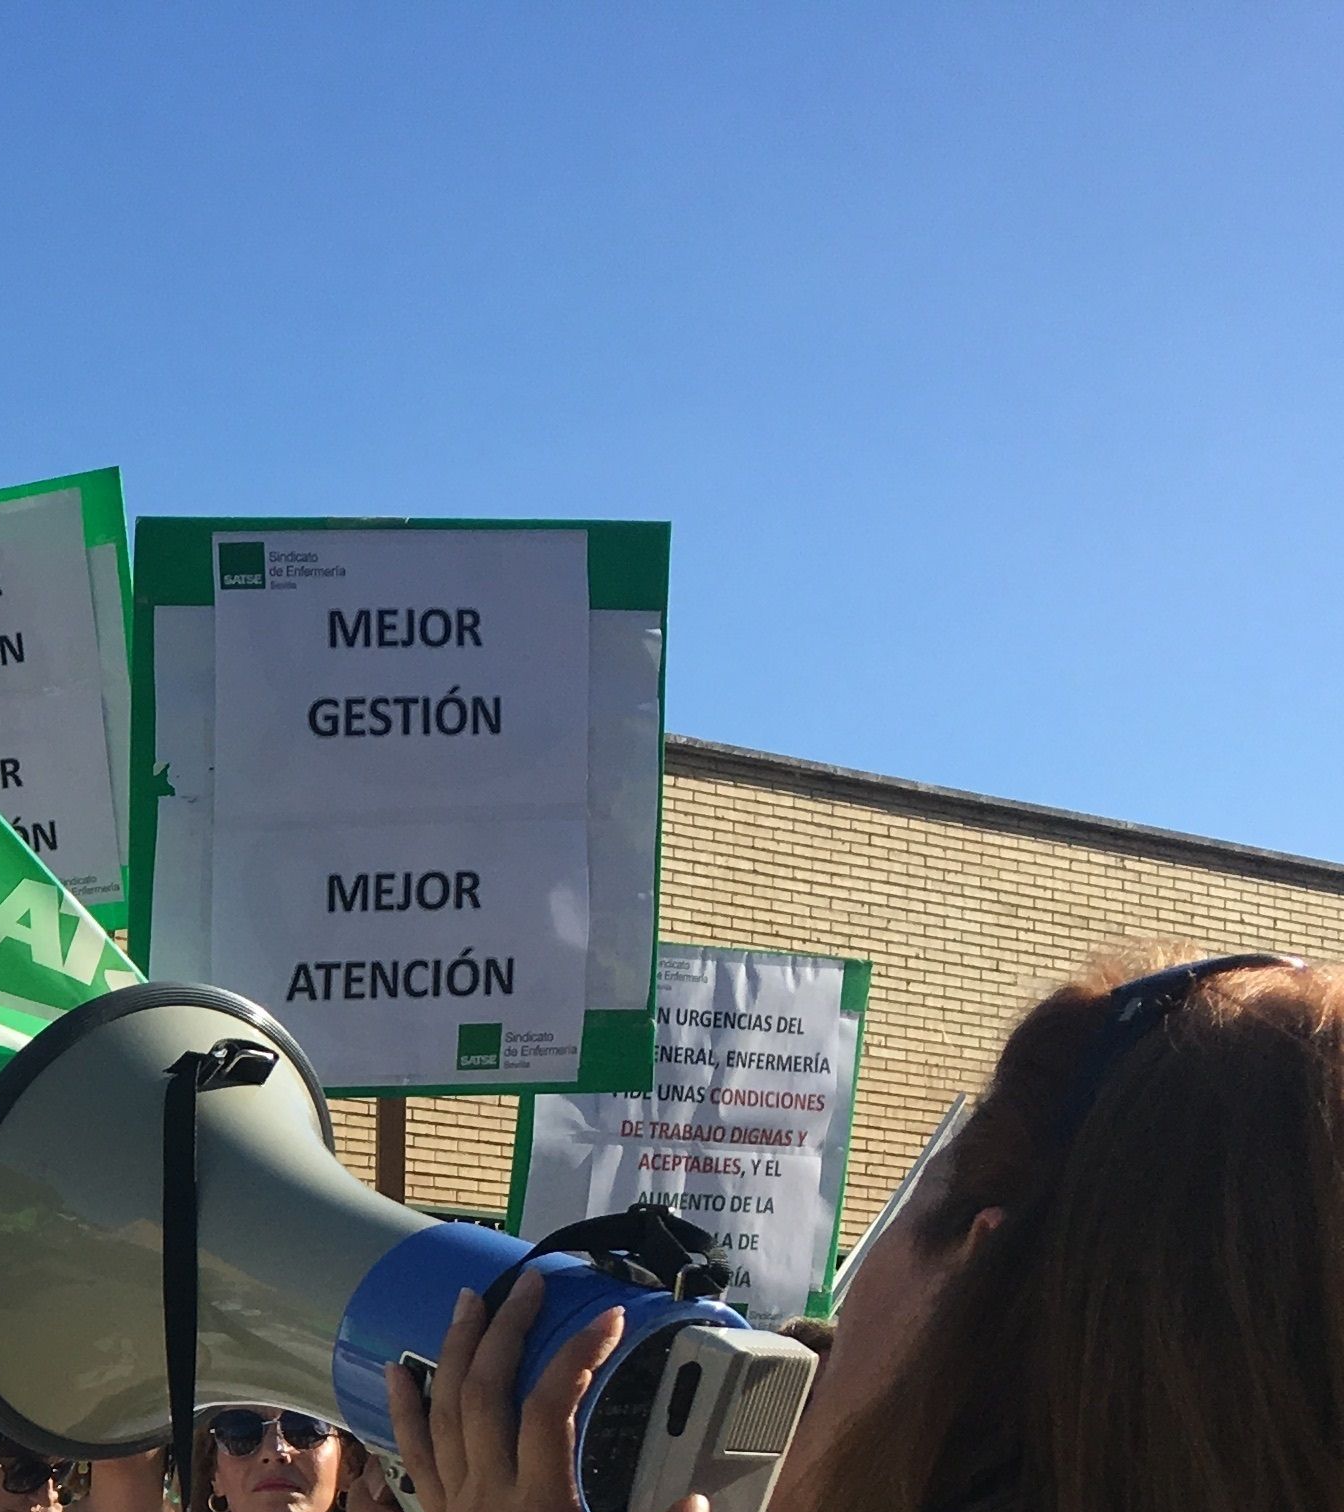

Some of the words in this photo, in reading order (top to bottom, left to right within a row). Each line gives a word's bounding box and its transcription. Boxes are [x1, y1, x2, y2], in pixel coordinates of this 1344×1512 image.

[269, 551, 319, 563] Sindicato
[328, 608, 483, 649] MEJOR
[308, 686, 502, 737] GESTIÓN
[327, 870, 481, 913] MEJOR
[286, 948, 515, 1002] ATENCIÓN
[675, 1007, 773, 1033] URGENCIAS
[776, 1017, 805, 1035] DEL
[505, 1032, 554, 1043] Sindicato
[726, 1048, 831, 1075] ENFERMERÍA
[657, 1084, 705, 1104] UNAS
[710, 1087, 825, 1112] CONDICIONES
[621, 1120, 644, 1138] DE
[649, 1122, 725, 1143] TRABAJO
[730, 1127, 793, 1147] DIGNAS
[798, 1130, 808, 1148] Y
[638, 1153, 745, 1178] ACEPTABLES,
[751, 1159, 761, 1176] Y
[765, 1160, 782, 1177] EL
[730, 1195, 751, 1214] DE
[755, 1197, 774, 1214] LA
[738, 1233, 759, 1250] DE
